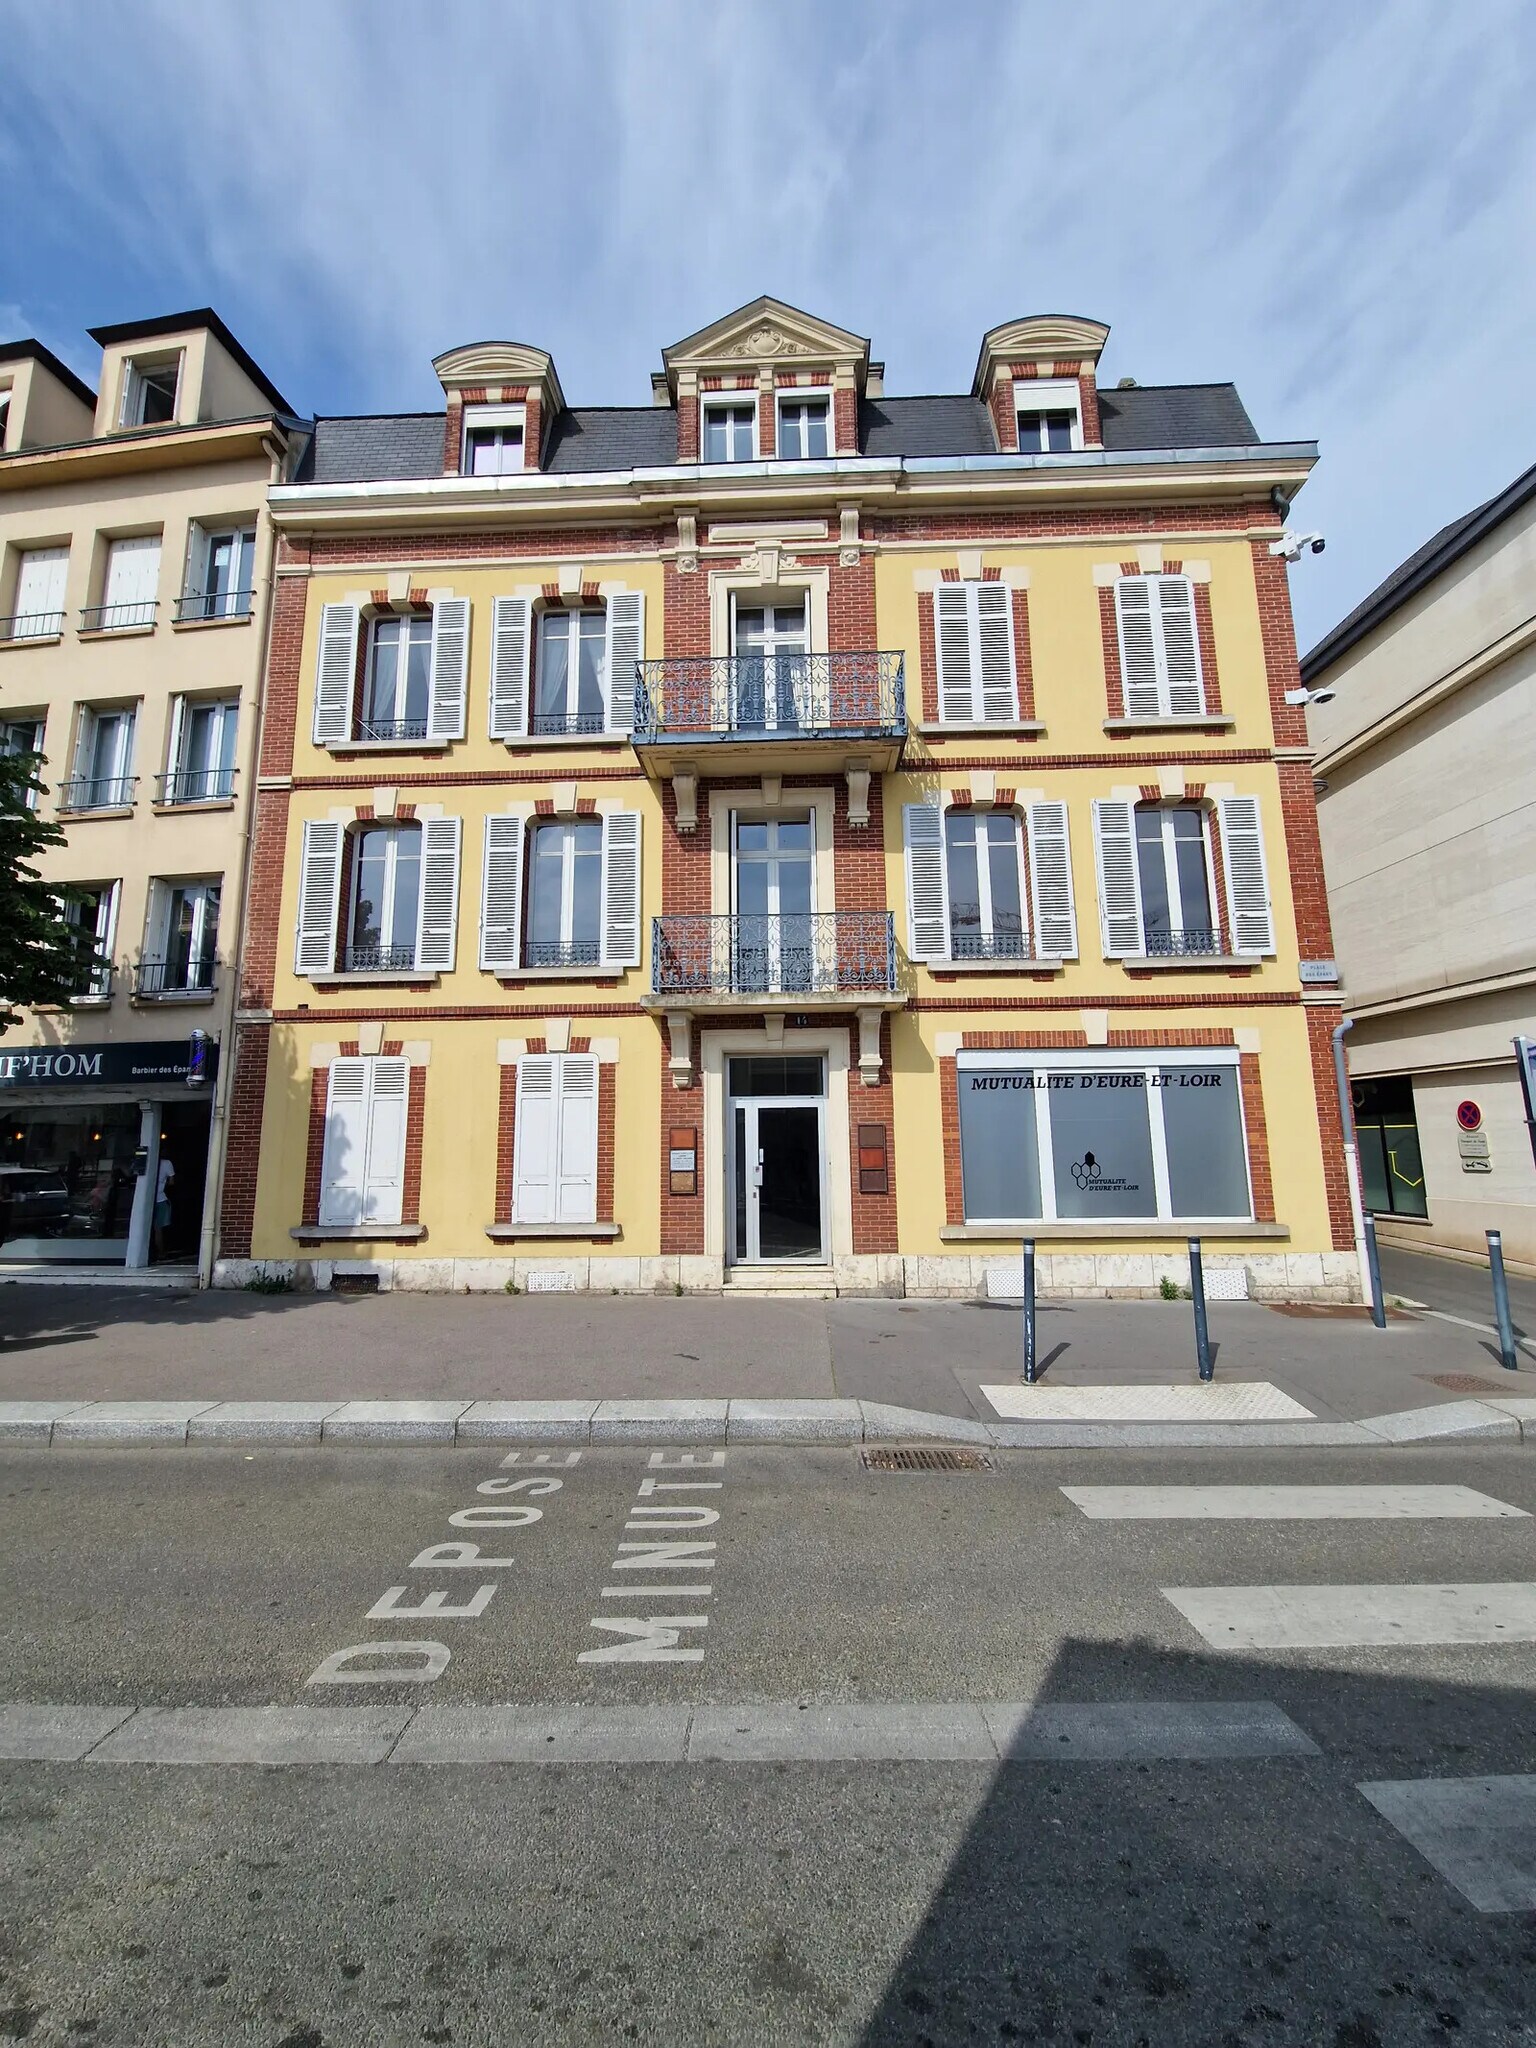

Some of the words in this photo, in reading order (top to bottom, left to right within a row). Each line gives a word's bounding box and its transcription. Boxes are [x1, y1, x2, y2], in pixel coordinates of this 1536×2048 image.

[131, 1066, 158, 1074] Barbier
[971, 1076, 1075, 1091] MUTUALITE
[307, 1451, 583, 1685] DEPOSE
[576, 1451, 727, 1664] MINUTE
